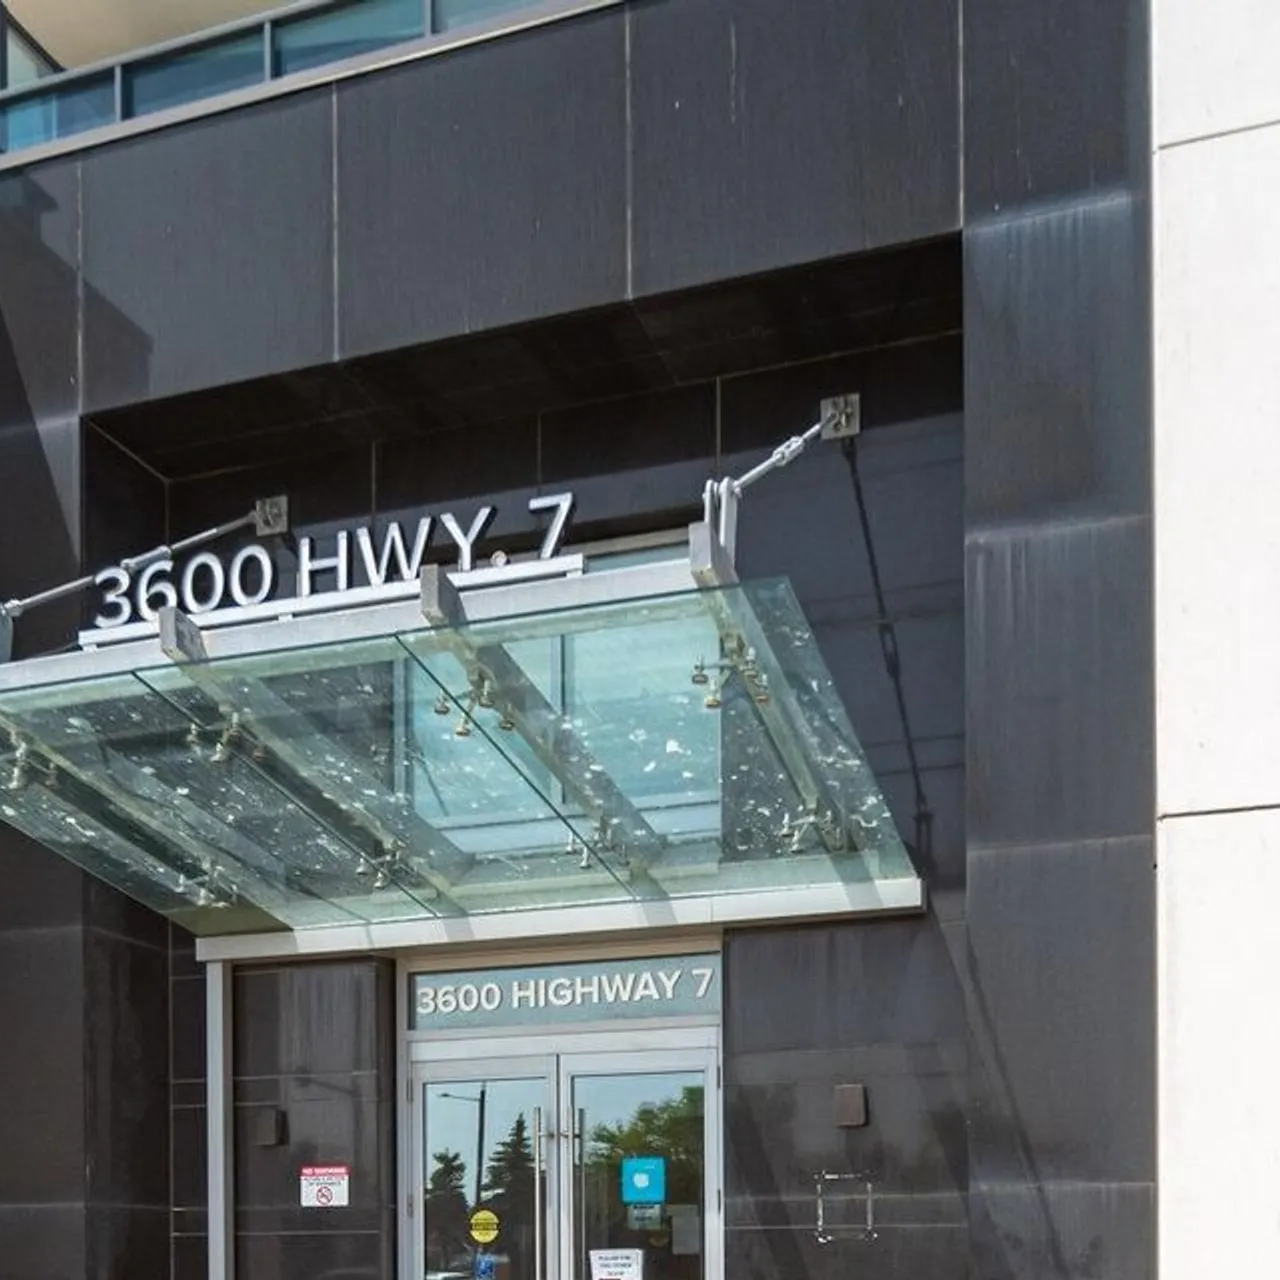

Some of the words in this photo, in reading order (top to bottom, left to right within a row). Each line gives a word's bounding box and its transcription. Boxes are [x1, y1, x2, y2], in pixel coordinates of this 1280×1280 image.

[91, 544, 274, 630] 3600
[527, 491, 575, 559] 7
[416, 982, 502, 1014] 3600
[511, 969, 682, 1009] HIGHWAY
[691, 967, 714, 998] 7
